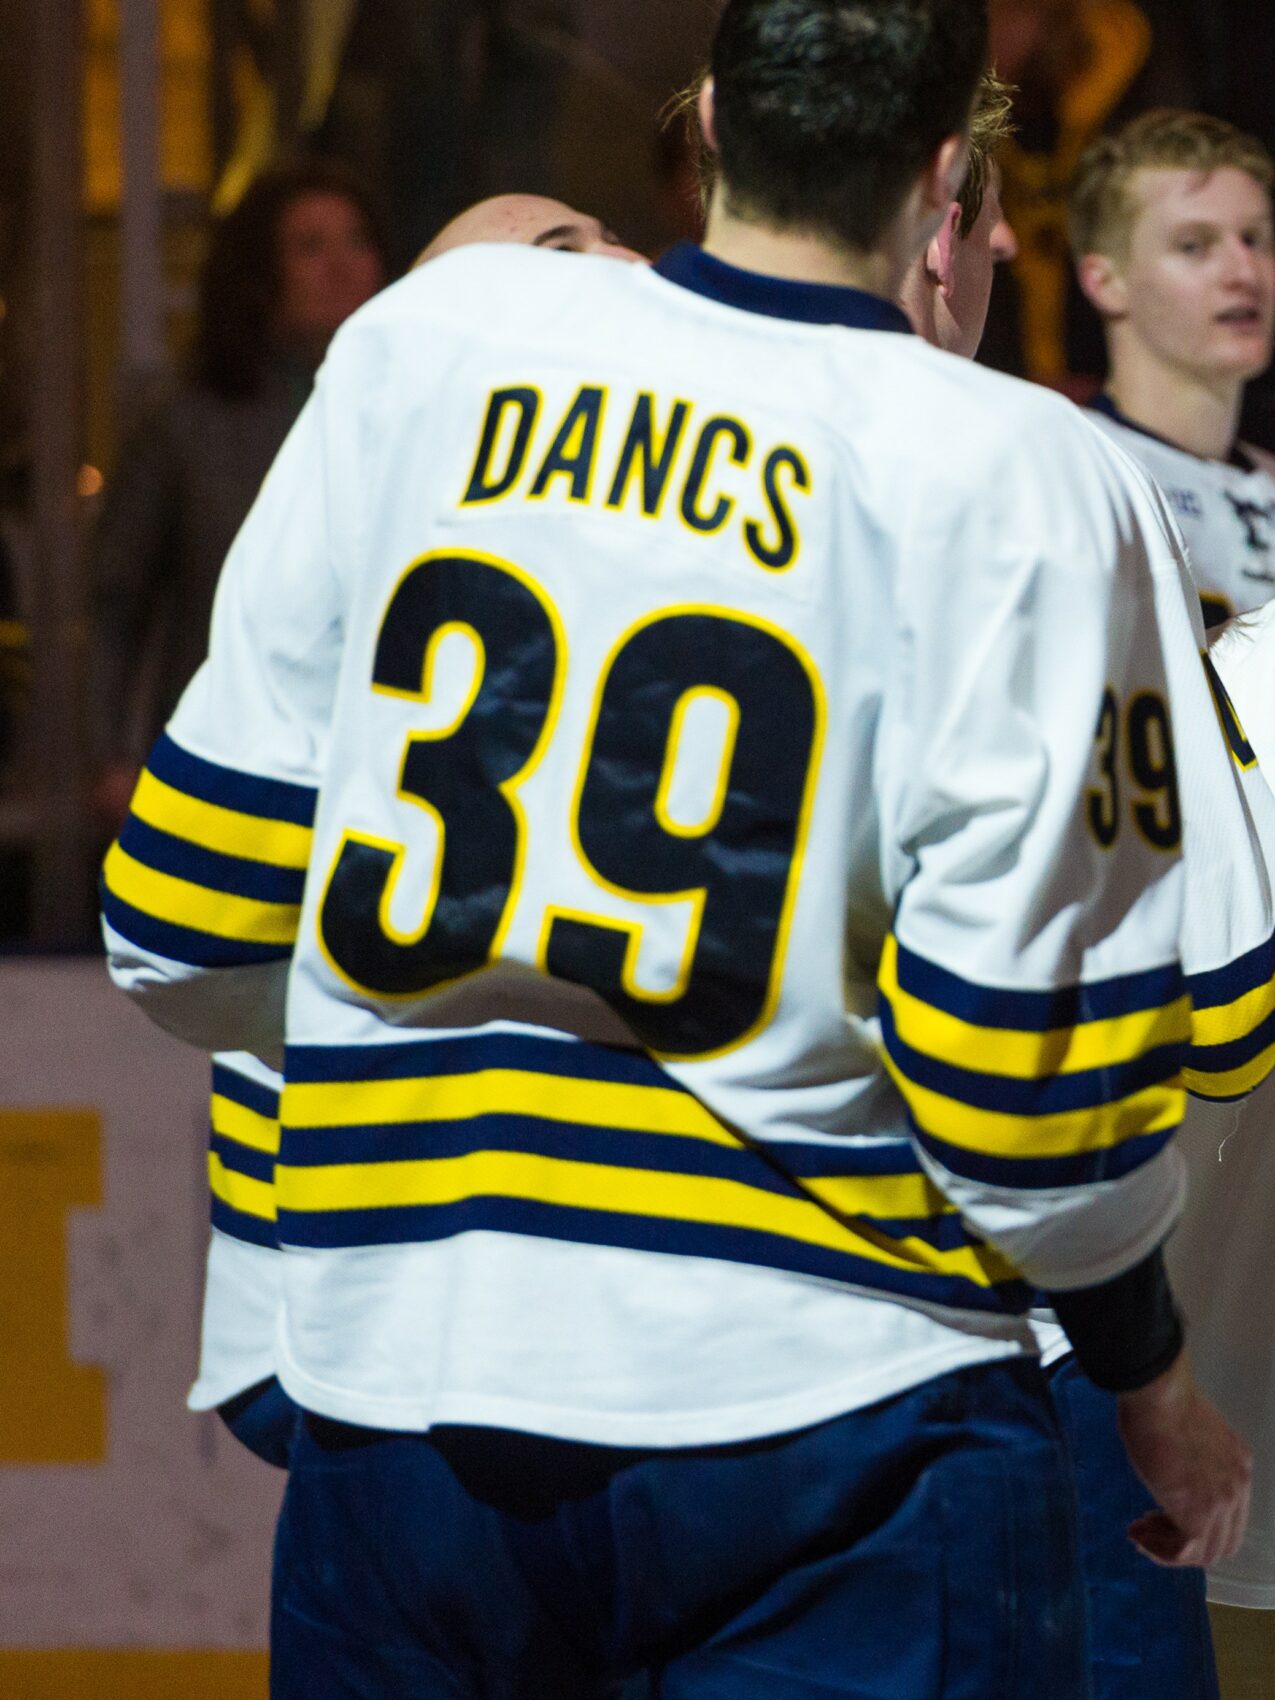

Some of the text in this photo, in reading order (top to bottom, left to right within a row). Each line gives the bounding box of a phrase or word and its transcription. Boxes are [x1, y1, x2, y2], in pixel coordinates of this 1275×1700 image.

[458, 382, 812, 573] DANCS
[315, 547, 828, 1062] 39
[1086, 683, 1184, 851] 39
